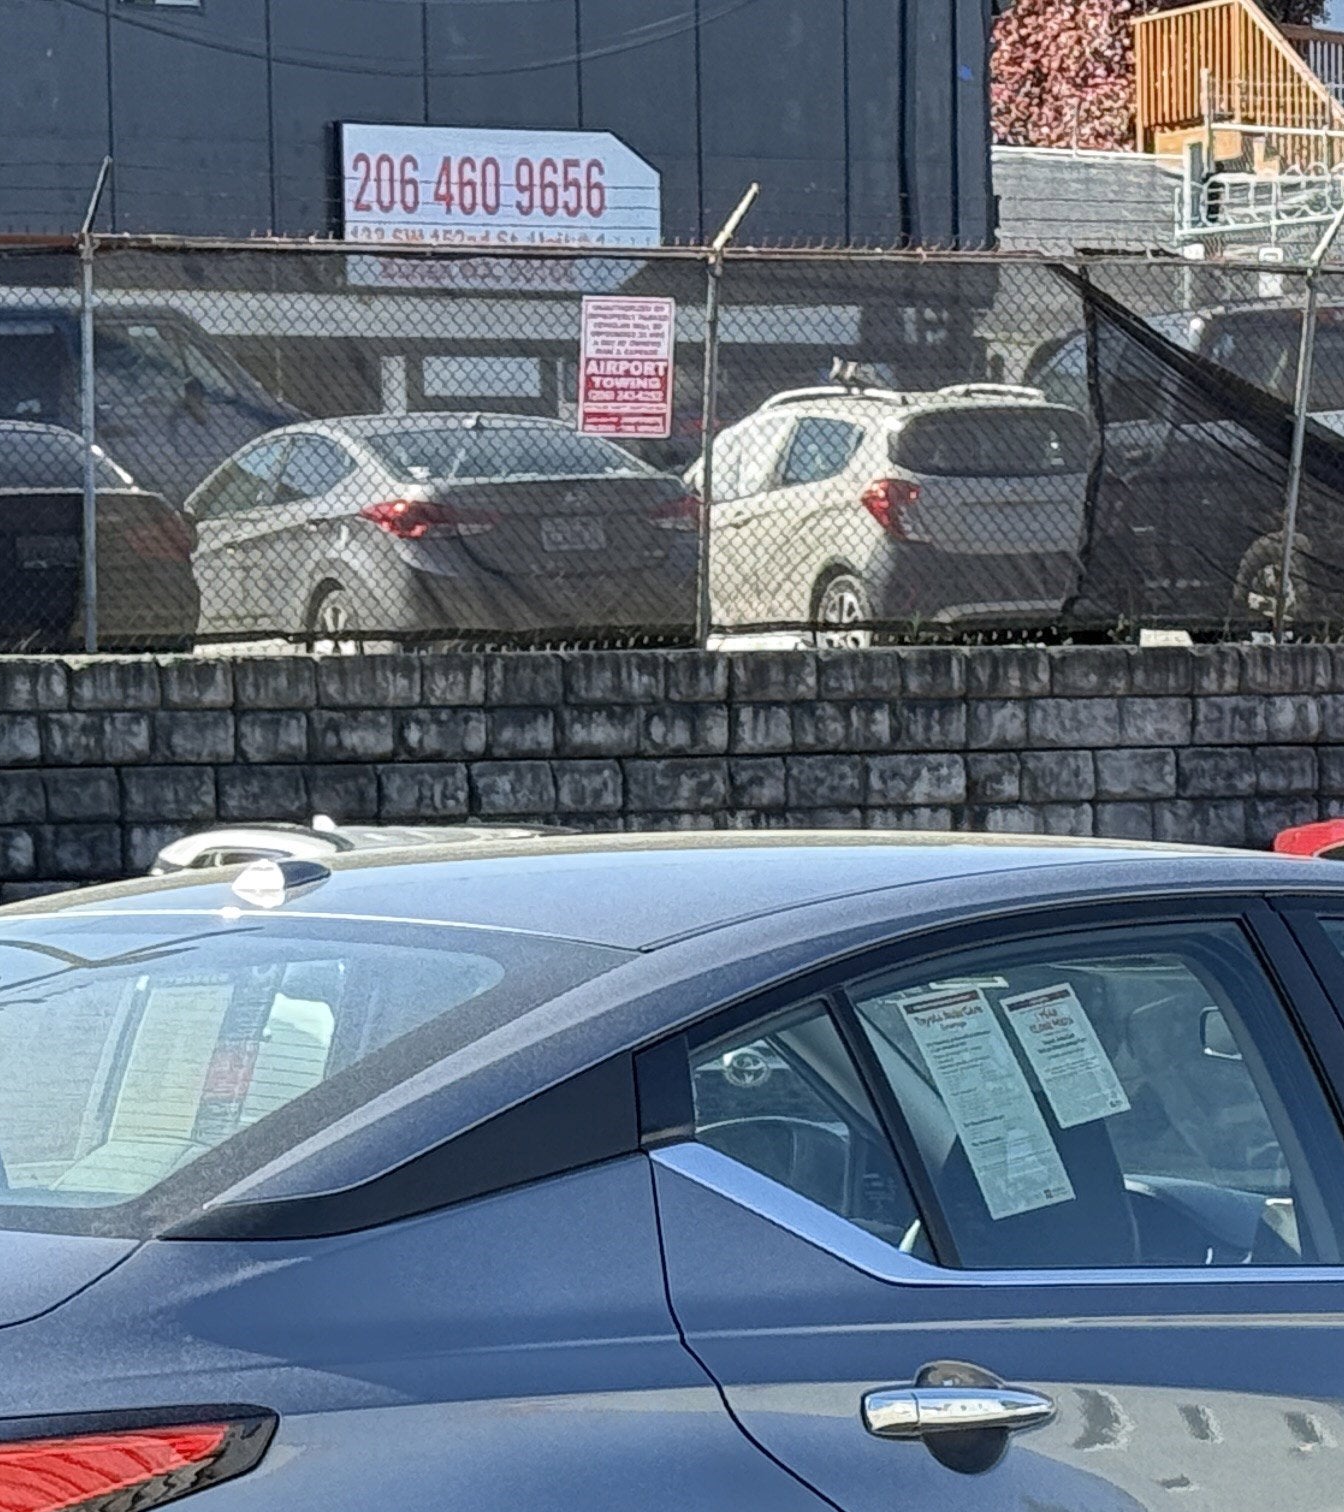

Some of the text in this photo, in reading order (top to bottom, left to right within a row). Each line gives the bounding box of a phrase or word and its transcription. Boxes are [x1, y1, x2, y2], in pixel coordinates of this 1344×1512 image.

[353, 153, 605, 218] 206 460 9656
[586, 360, 668, 376] AIRPORT
[590, 376, 662, 389] TOWING
